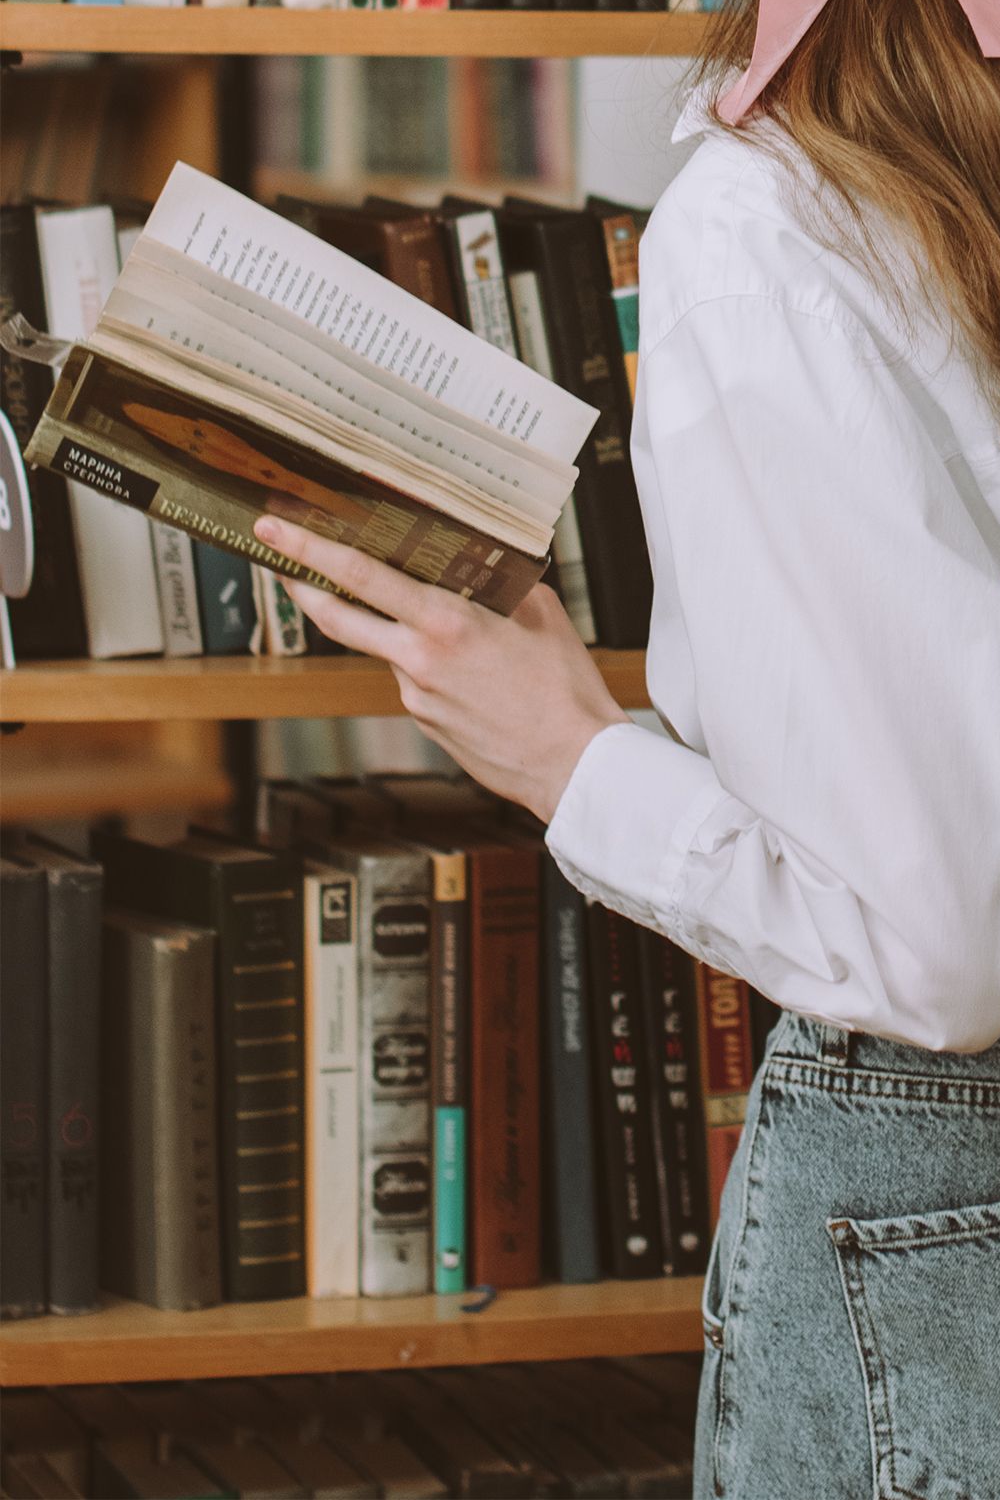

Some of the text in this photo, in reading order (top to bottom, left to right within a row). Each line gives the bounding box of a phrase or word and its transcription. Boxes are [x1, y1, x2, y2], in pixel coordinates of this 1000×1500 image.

[62, 460, 131, 500] СТЕПНОВА
[67, 447, 123, 484] МАРИНА
[59, 1100, 94, 1148] 6
